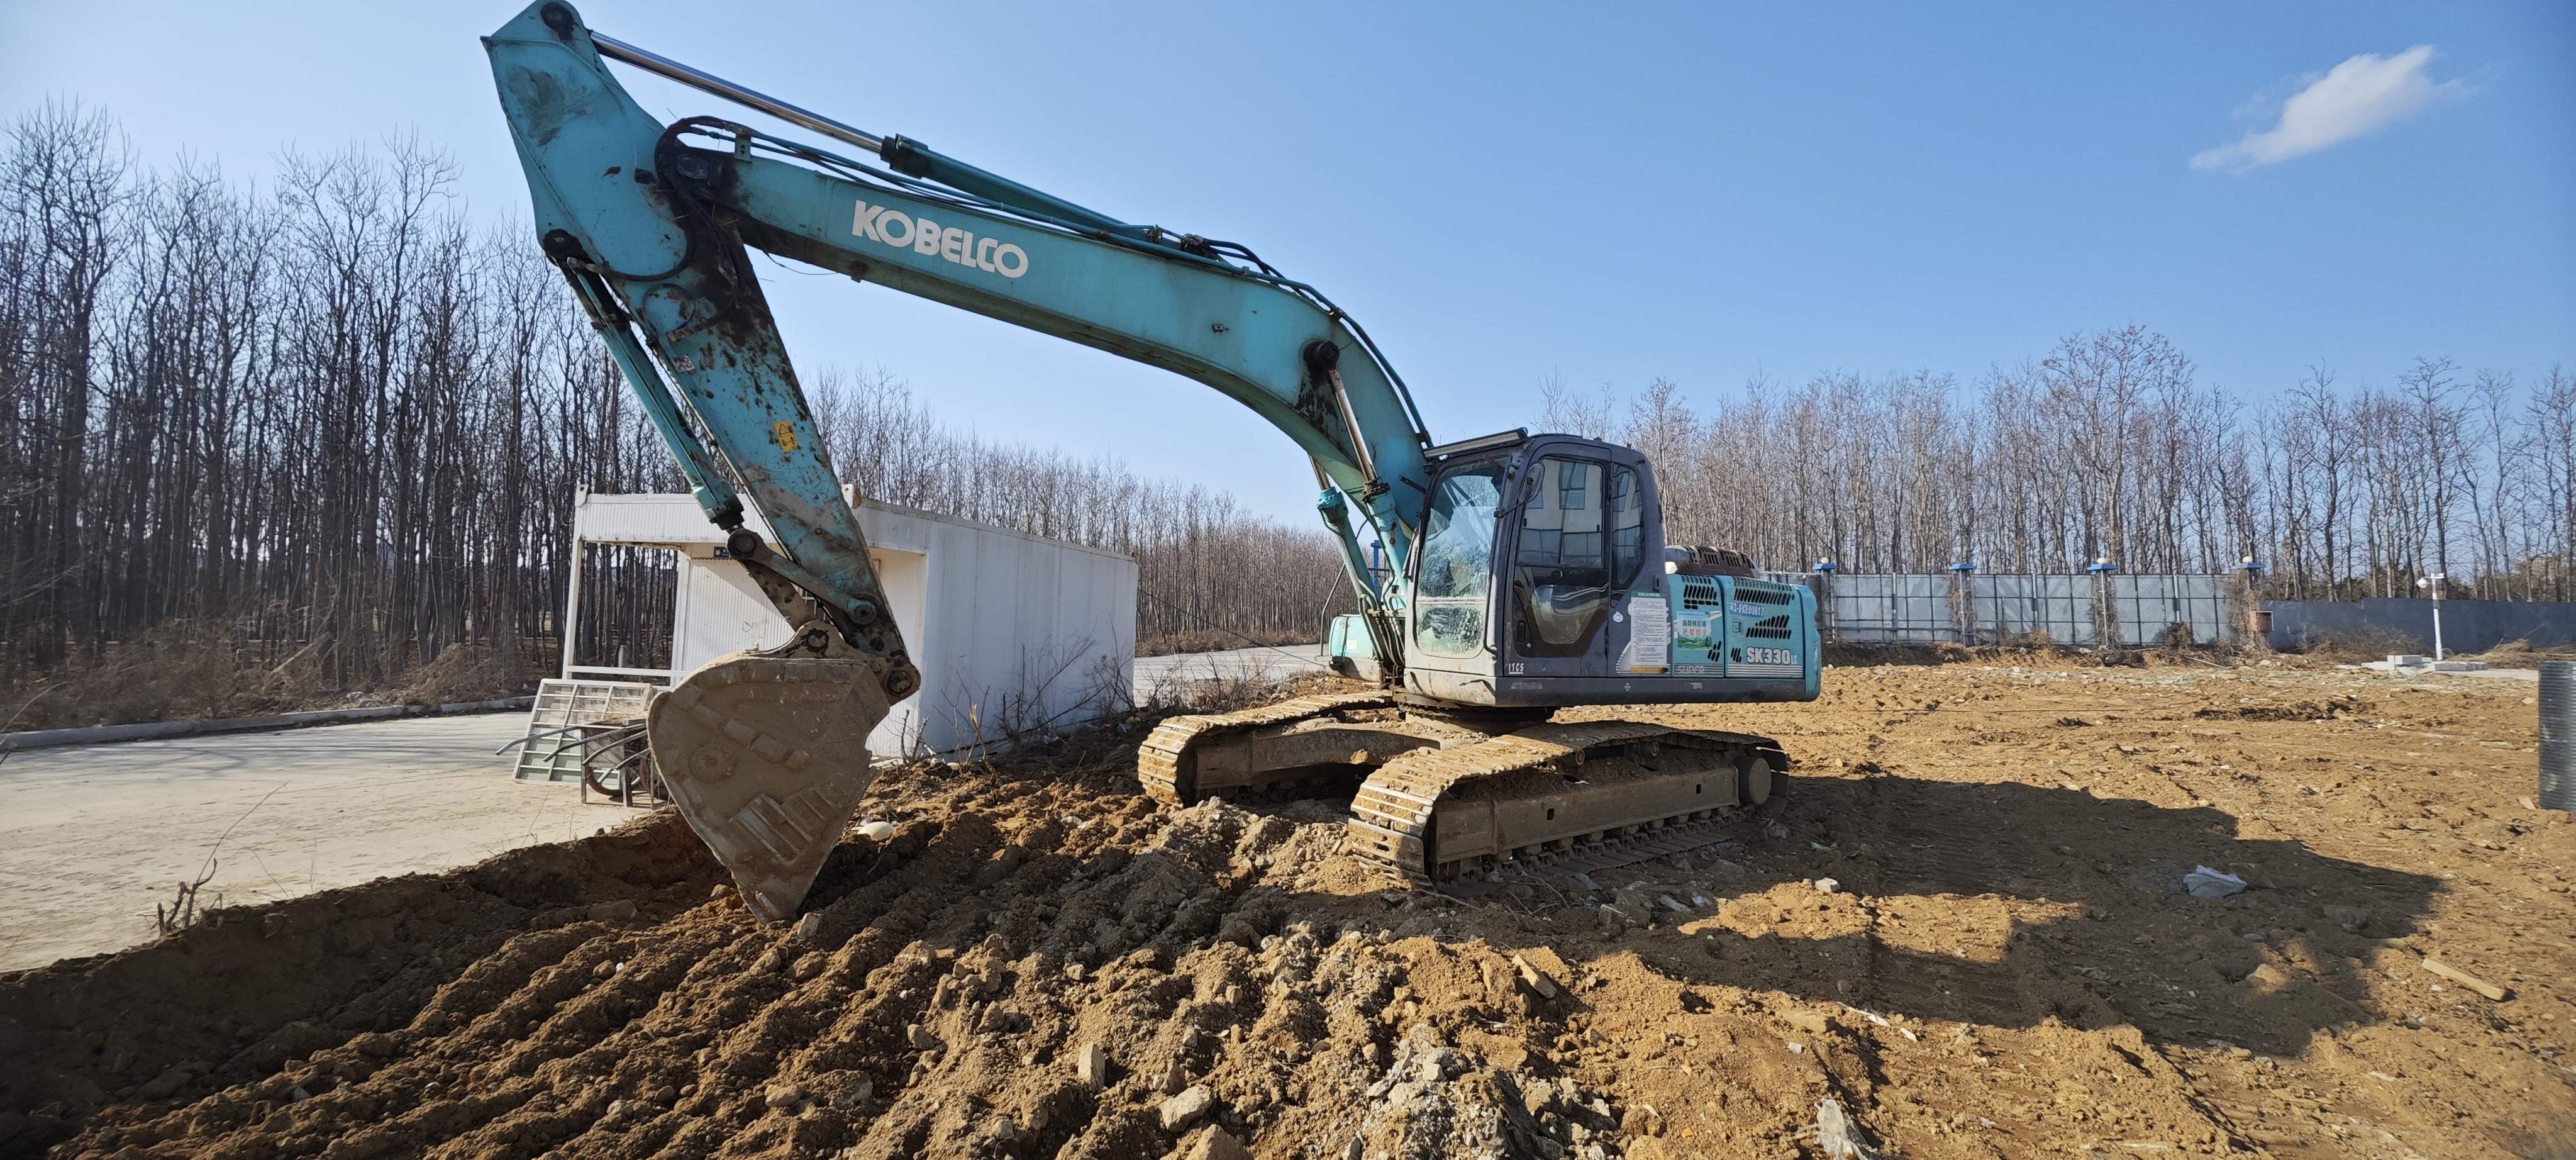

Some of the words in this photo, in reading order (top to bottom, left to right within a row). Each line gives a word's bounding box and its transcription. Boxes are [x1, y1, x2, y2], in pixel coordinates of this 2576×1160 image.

[852, 199, 1029, 279] KOBELCO
[1746, 646, 1791, 665] SK330
[1791, 654, 1798, 664] LC
[1509, 662, 1524, 672] ITCS
[1676, 666, 1705, 674] SUPER
